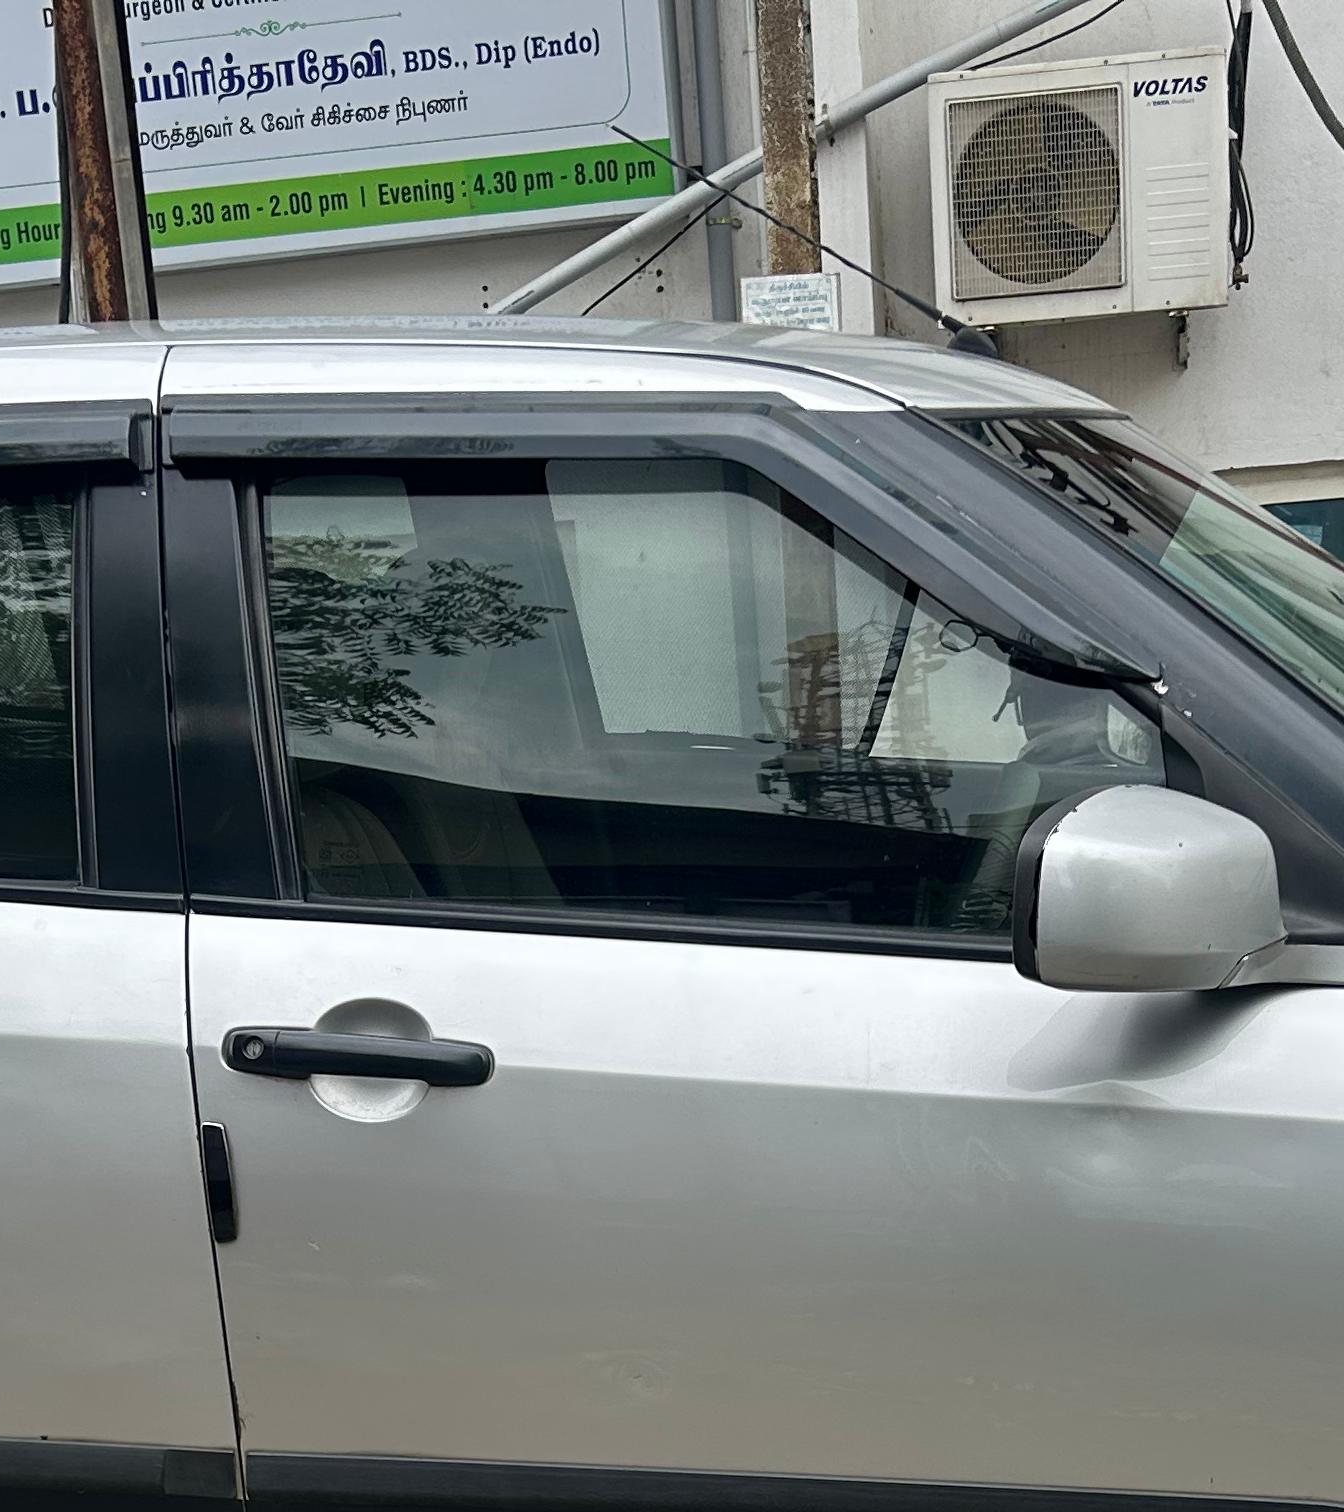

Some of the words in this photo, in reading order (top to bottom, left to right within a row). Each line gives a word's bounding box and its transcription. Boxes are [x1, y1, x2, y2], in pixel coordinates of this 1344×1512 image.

[403, 47, 467, 73] BDS.,
[475, 39, 516, 68] Dip
[524, 28, 600, 65] (Endo)
[1133, 76, 1208, 97] VOLTAS
[240, 115, 256, 135] &
[261, 107, 304, 133] வேர்
[311, 101, 389, 127] சிகிச்சை
[395, 90, 468, 125] நிபுணர்
[173, 202, 215, 228] 9.30
[221, 202, 250, 222] am
[269, 191, 312, 217] 2.00
[318, 194, 348, 216] pm
[379, 180, 455, 207] Evening
[473, 170, 517, 196] 4.30
[524, 171, 554, 197] pm
[575, 160, 618, 186] 8.00
[625, 160, 656, 183] pm
[16, 220, 60, 245] Hour
